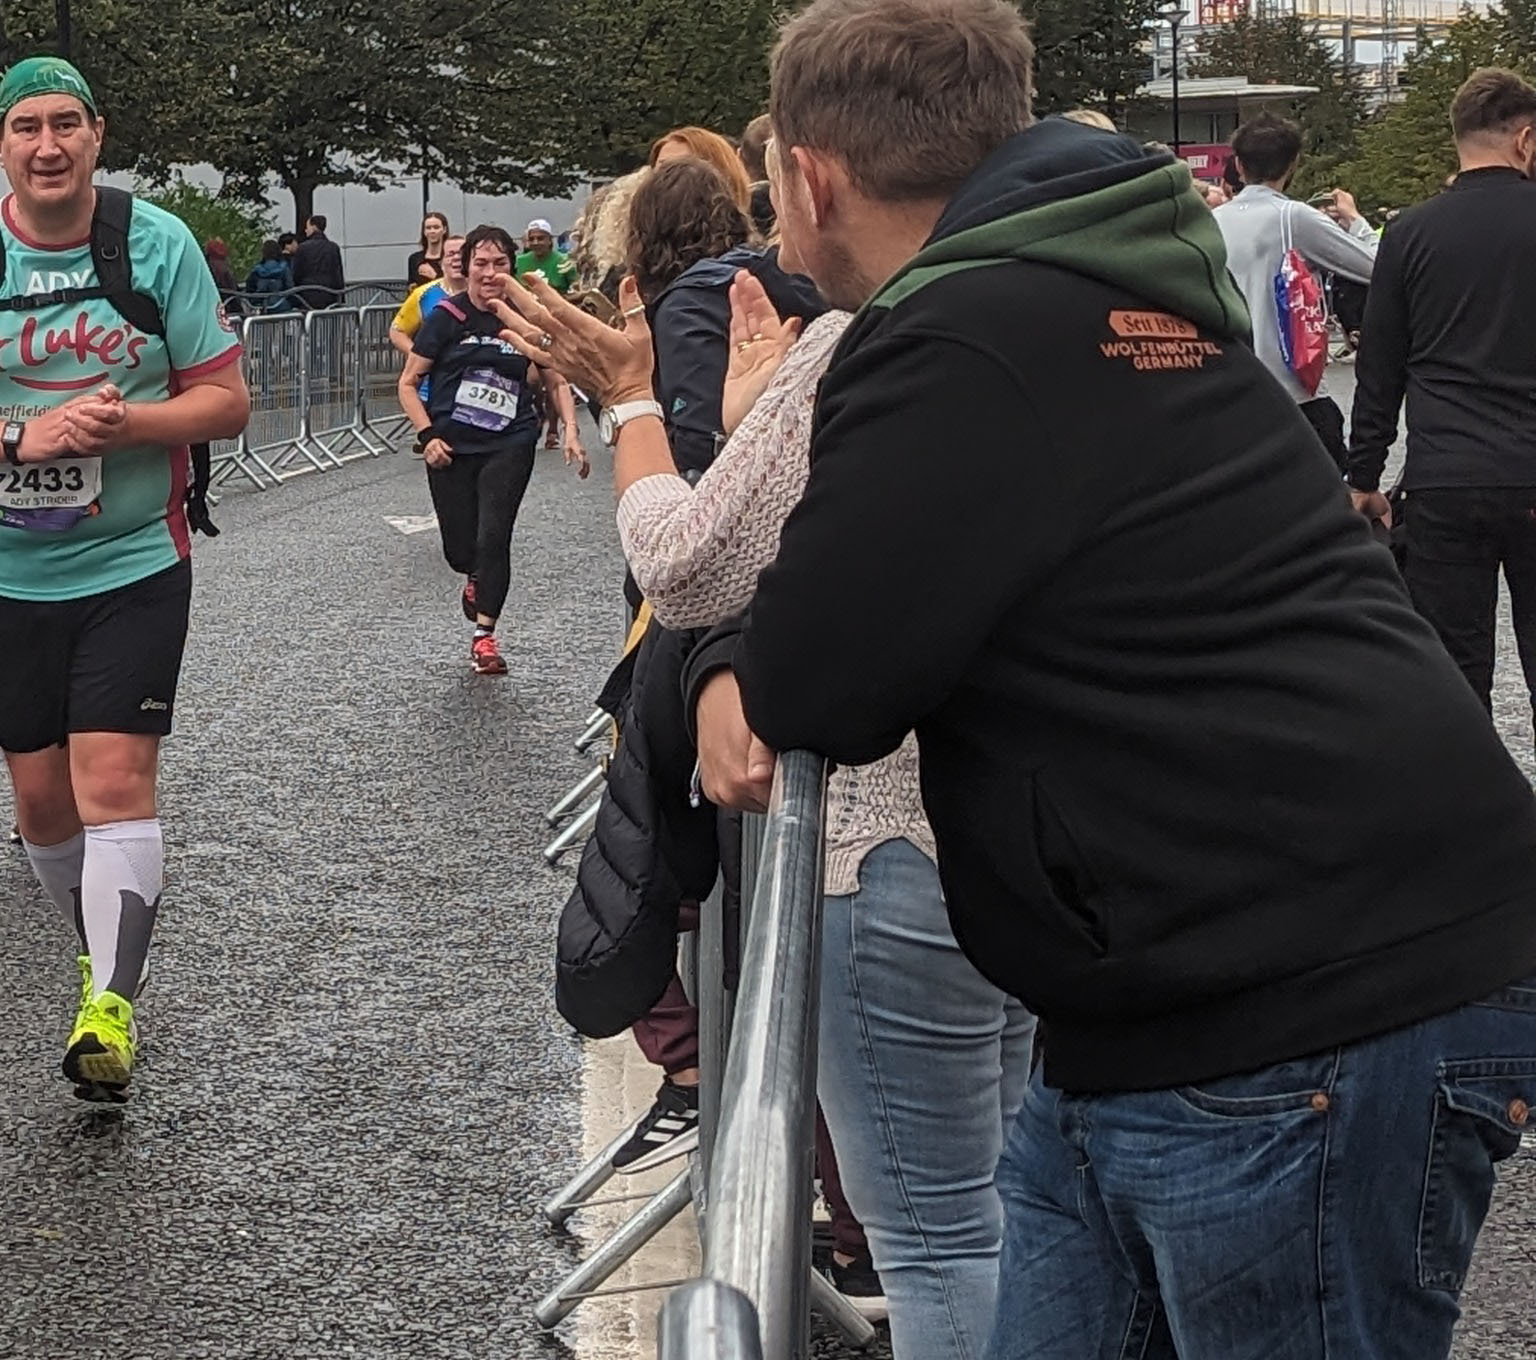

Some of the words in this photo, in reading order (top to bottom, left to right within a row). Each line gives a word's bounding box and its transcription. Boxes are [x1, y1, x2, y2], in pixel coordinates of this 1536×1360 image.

[25, 268, 91, 296] ADY
[20, 311, 148, 369] Luke's
[1100, 340, 1223, 357] WOLFENBÜTTEL
[1133, 355, 1203, 370] GERMANY
[469, 387, 506, 408] 3781
[5, 466, 84, 493] 2433
